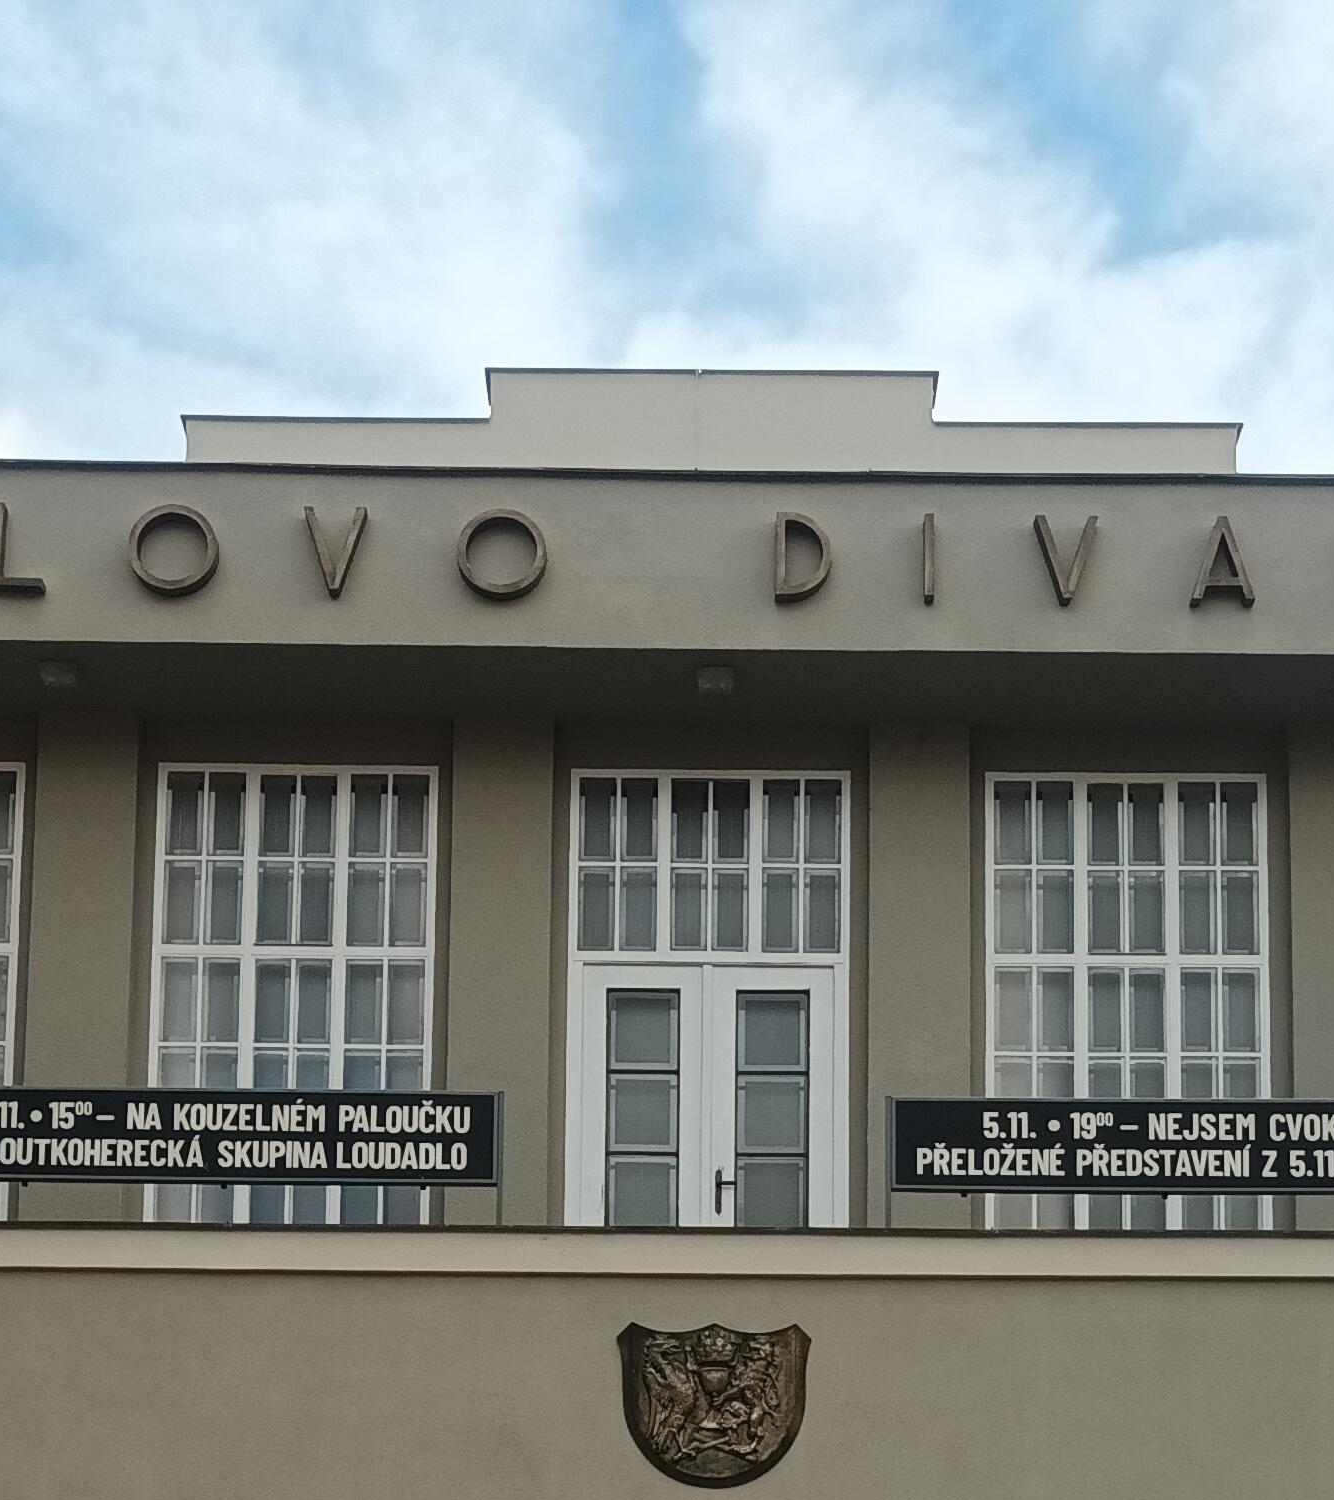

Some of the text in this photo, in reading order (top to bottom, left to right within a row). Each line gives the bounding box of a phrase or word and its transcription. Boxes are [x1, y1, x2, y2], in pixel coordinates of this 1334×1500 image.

[126, 1102, 162, 1131] NA
[173, 1098, 326, 1133] KOUZELNÉM
[338, 1099, 471, 1134] PALOUČKU
[982, 1111, 1037, 1139] 5.11.
[1148, 1112, 1256, 1141] NEJSEM
[217, 1140, 328, 1169] SKUPINA
[336, 1141, 468, 1171] LOUDADLO
[916, 1146, 1066, 1177] PŘELOŽENÉ
[1076, 1146, 1251, 1178] PŘEDSTAVENÍ
[1261, 1150, 1278, 1178] Z
